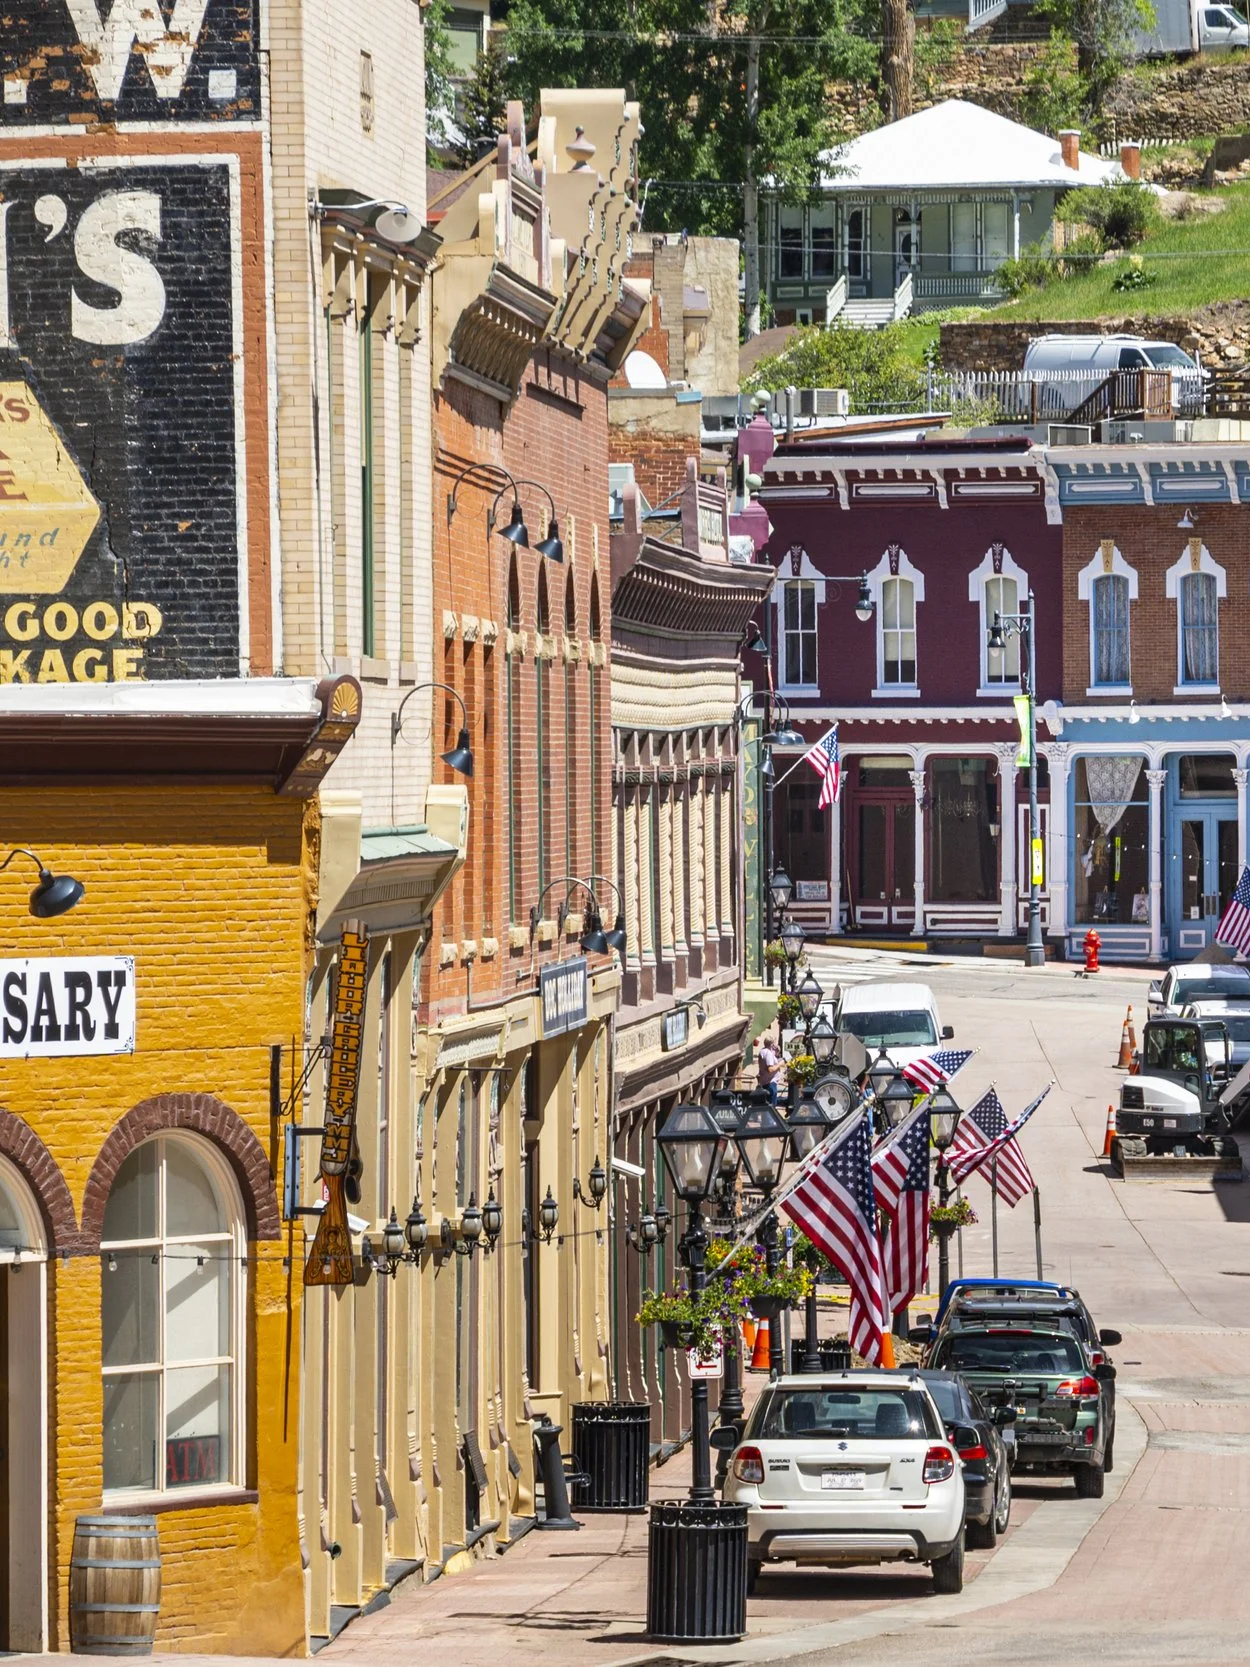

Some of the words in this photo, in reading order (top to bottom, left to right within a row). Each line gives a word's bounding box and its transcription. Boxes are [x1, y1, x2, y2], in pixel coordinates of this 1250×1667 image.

[4, 601, 163, 641] GOOD
[2, 970, 127, 1044] SARY
[166, 1440, 217, 1482] ATM
